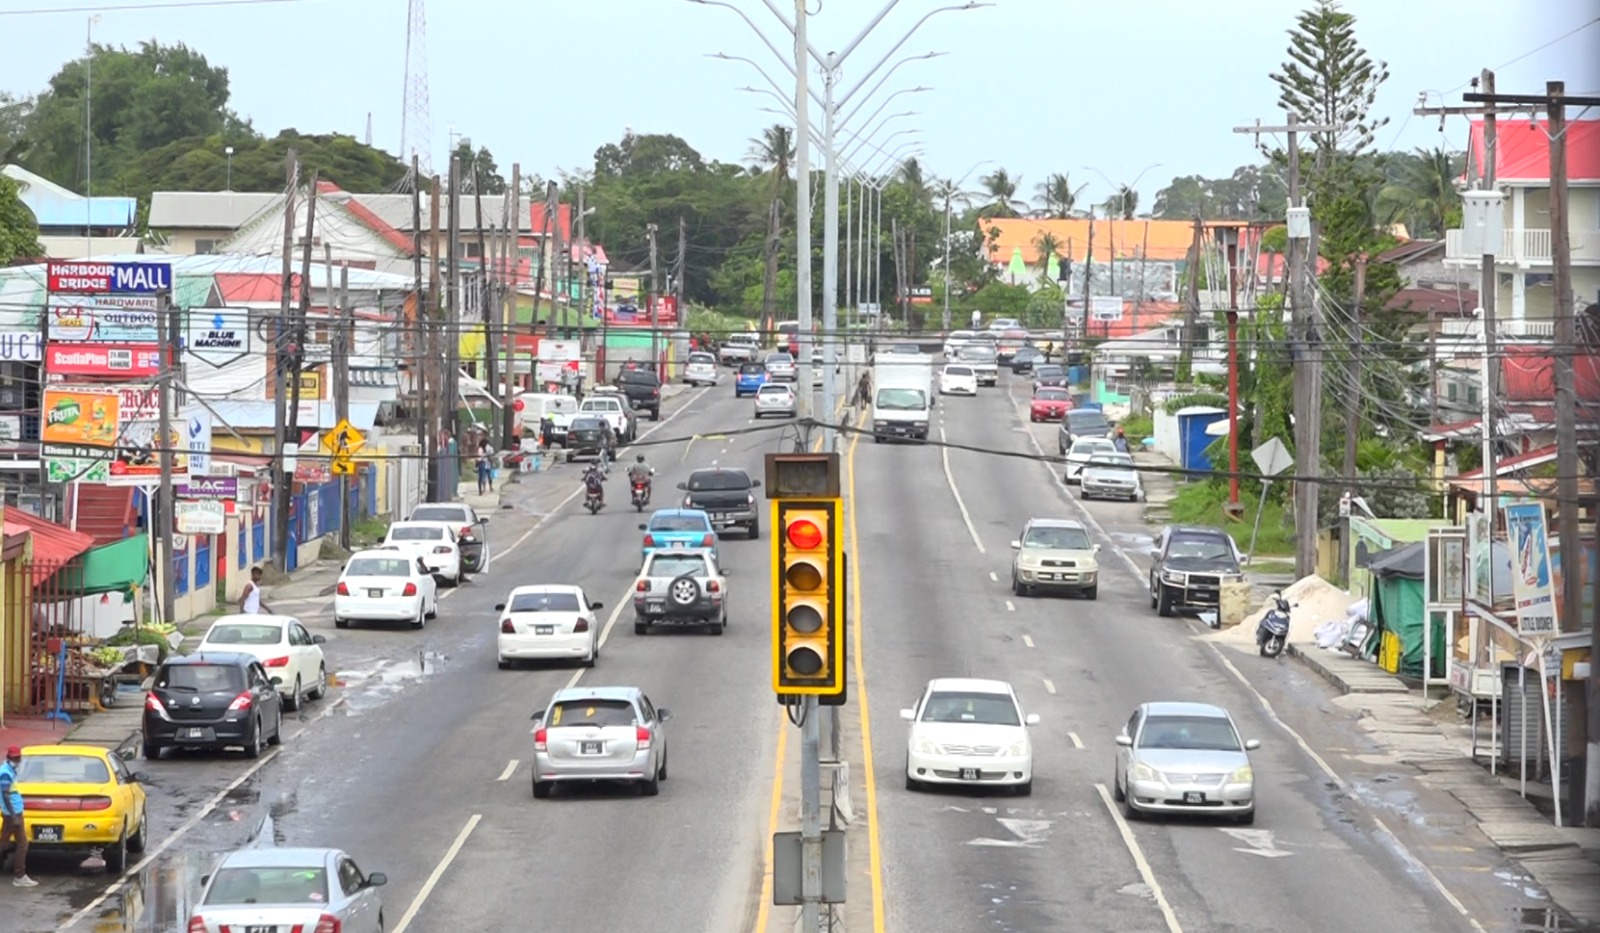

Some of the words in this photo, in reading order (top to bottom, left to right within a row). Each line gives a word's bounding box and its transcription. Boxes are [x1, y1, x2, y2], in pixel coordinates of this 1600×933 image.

[51, 264, 115, 277] HARBOUR
[116, 266, 168, 289] MALL
[58, 278, 107, 289] BRIDGE
[95, 298, 157, 307] HARDWARE
[104, 313, 157, 323] OUTDOO
[208, 330, 235, 339] BLUE
[194, 339, 242, 348] MACHINE
